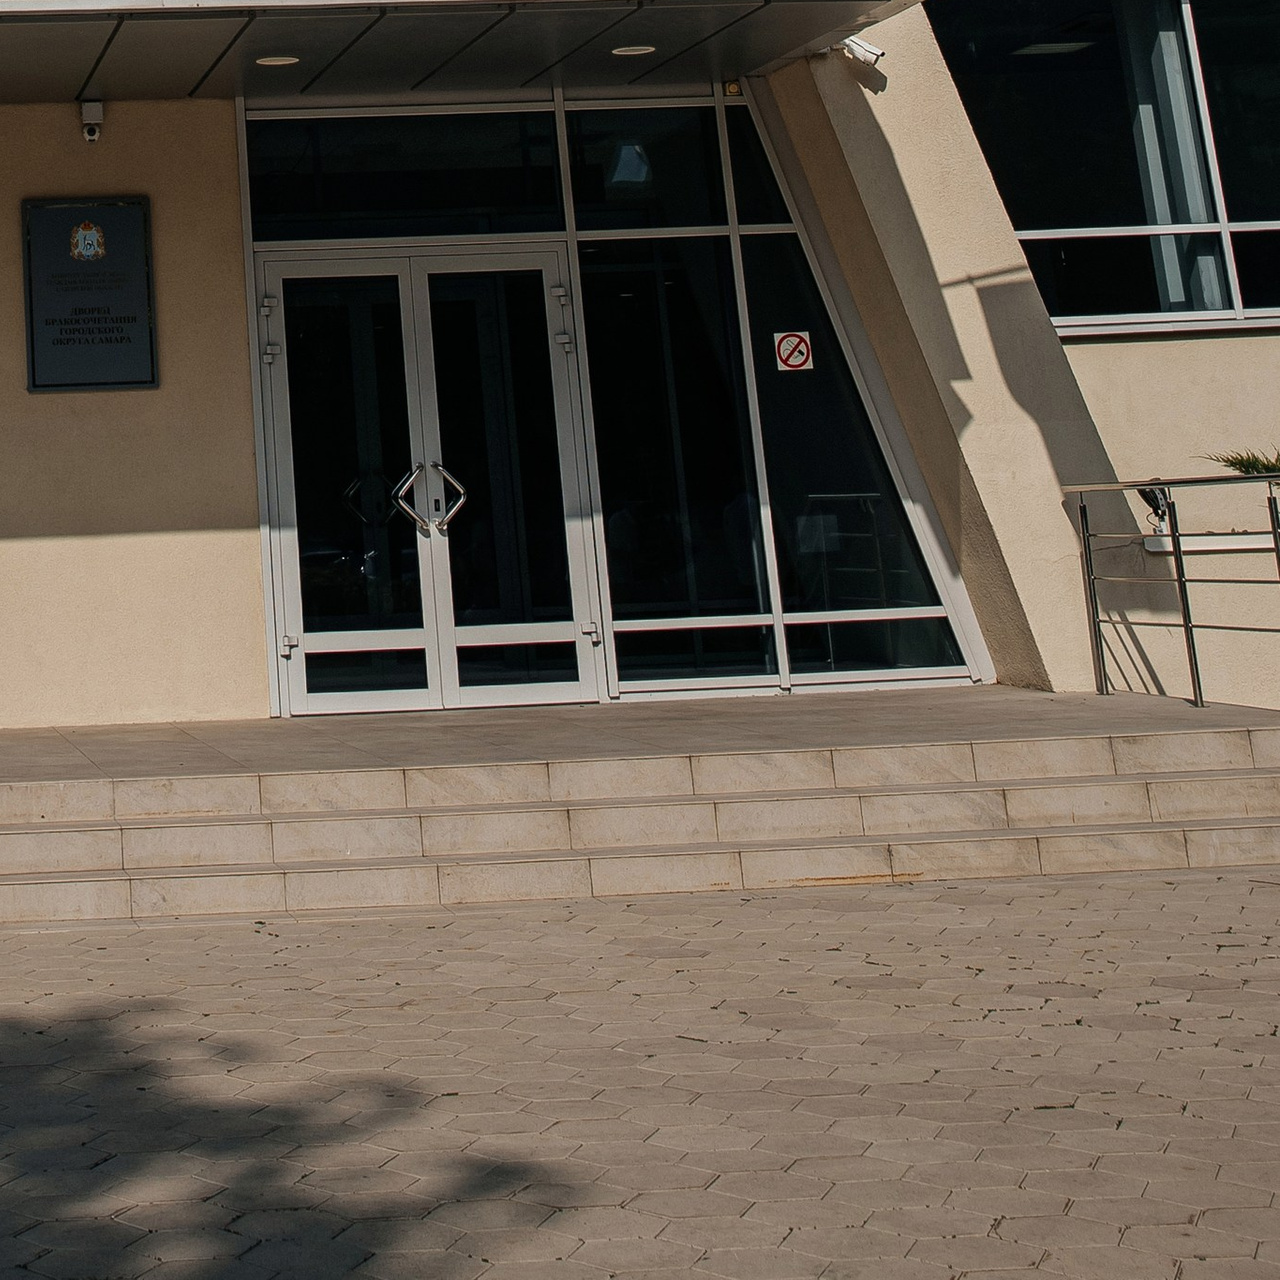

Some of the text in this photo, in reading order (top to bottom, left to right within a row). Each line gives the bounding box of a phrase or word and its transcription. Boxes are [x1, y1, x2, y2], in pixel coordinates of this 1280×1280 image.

[70, 306, 111, 316] ДВОРЕЦ
[45, 316, 137, 326] БРАКОСОЧЕТАНИЯ
[59, 326, 124, 336] ГОРОДСКОГО
[51, 335, 132, 346] ОКРУГА САМАРА
